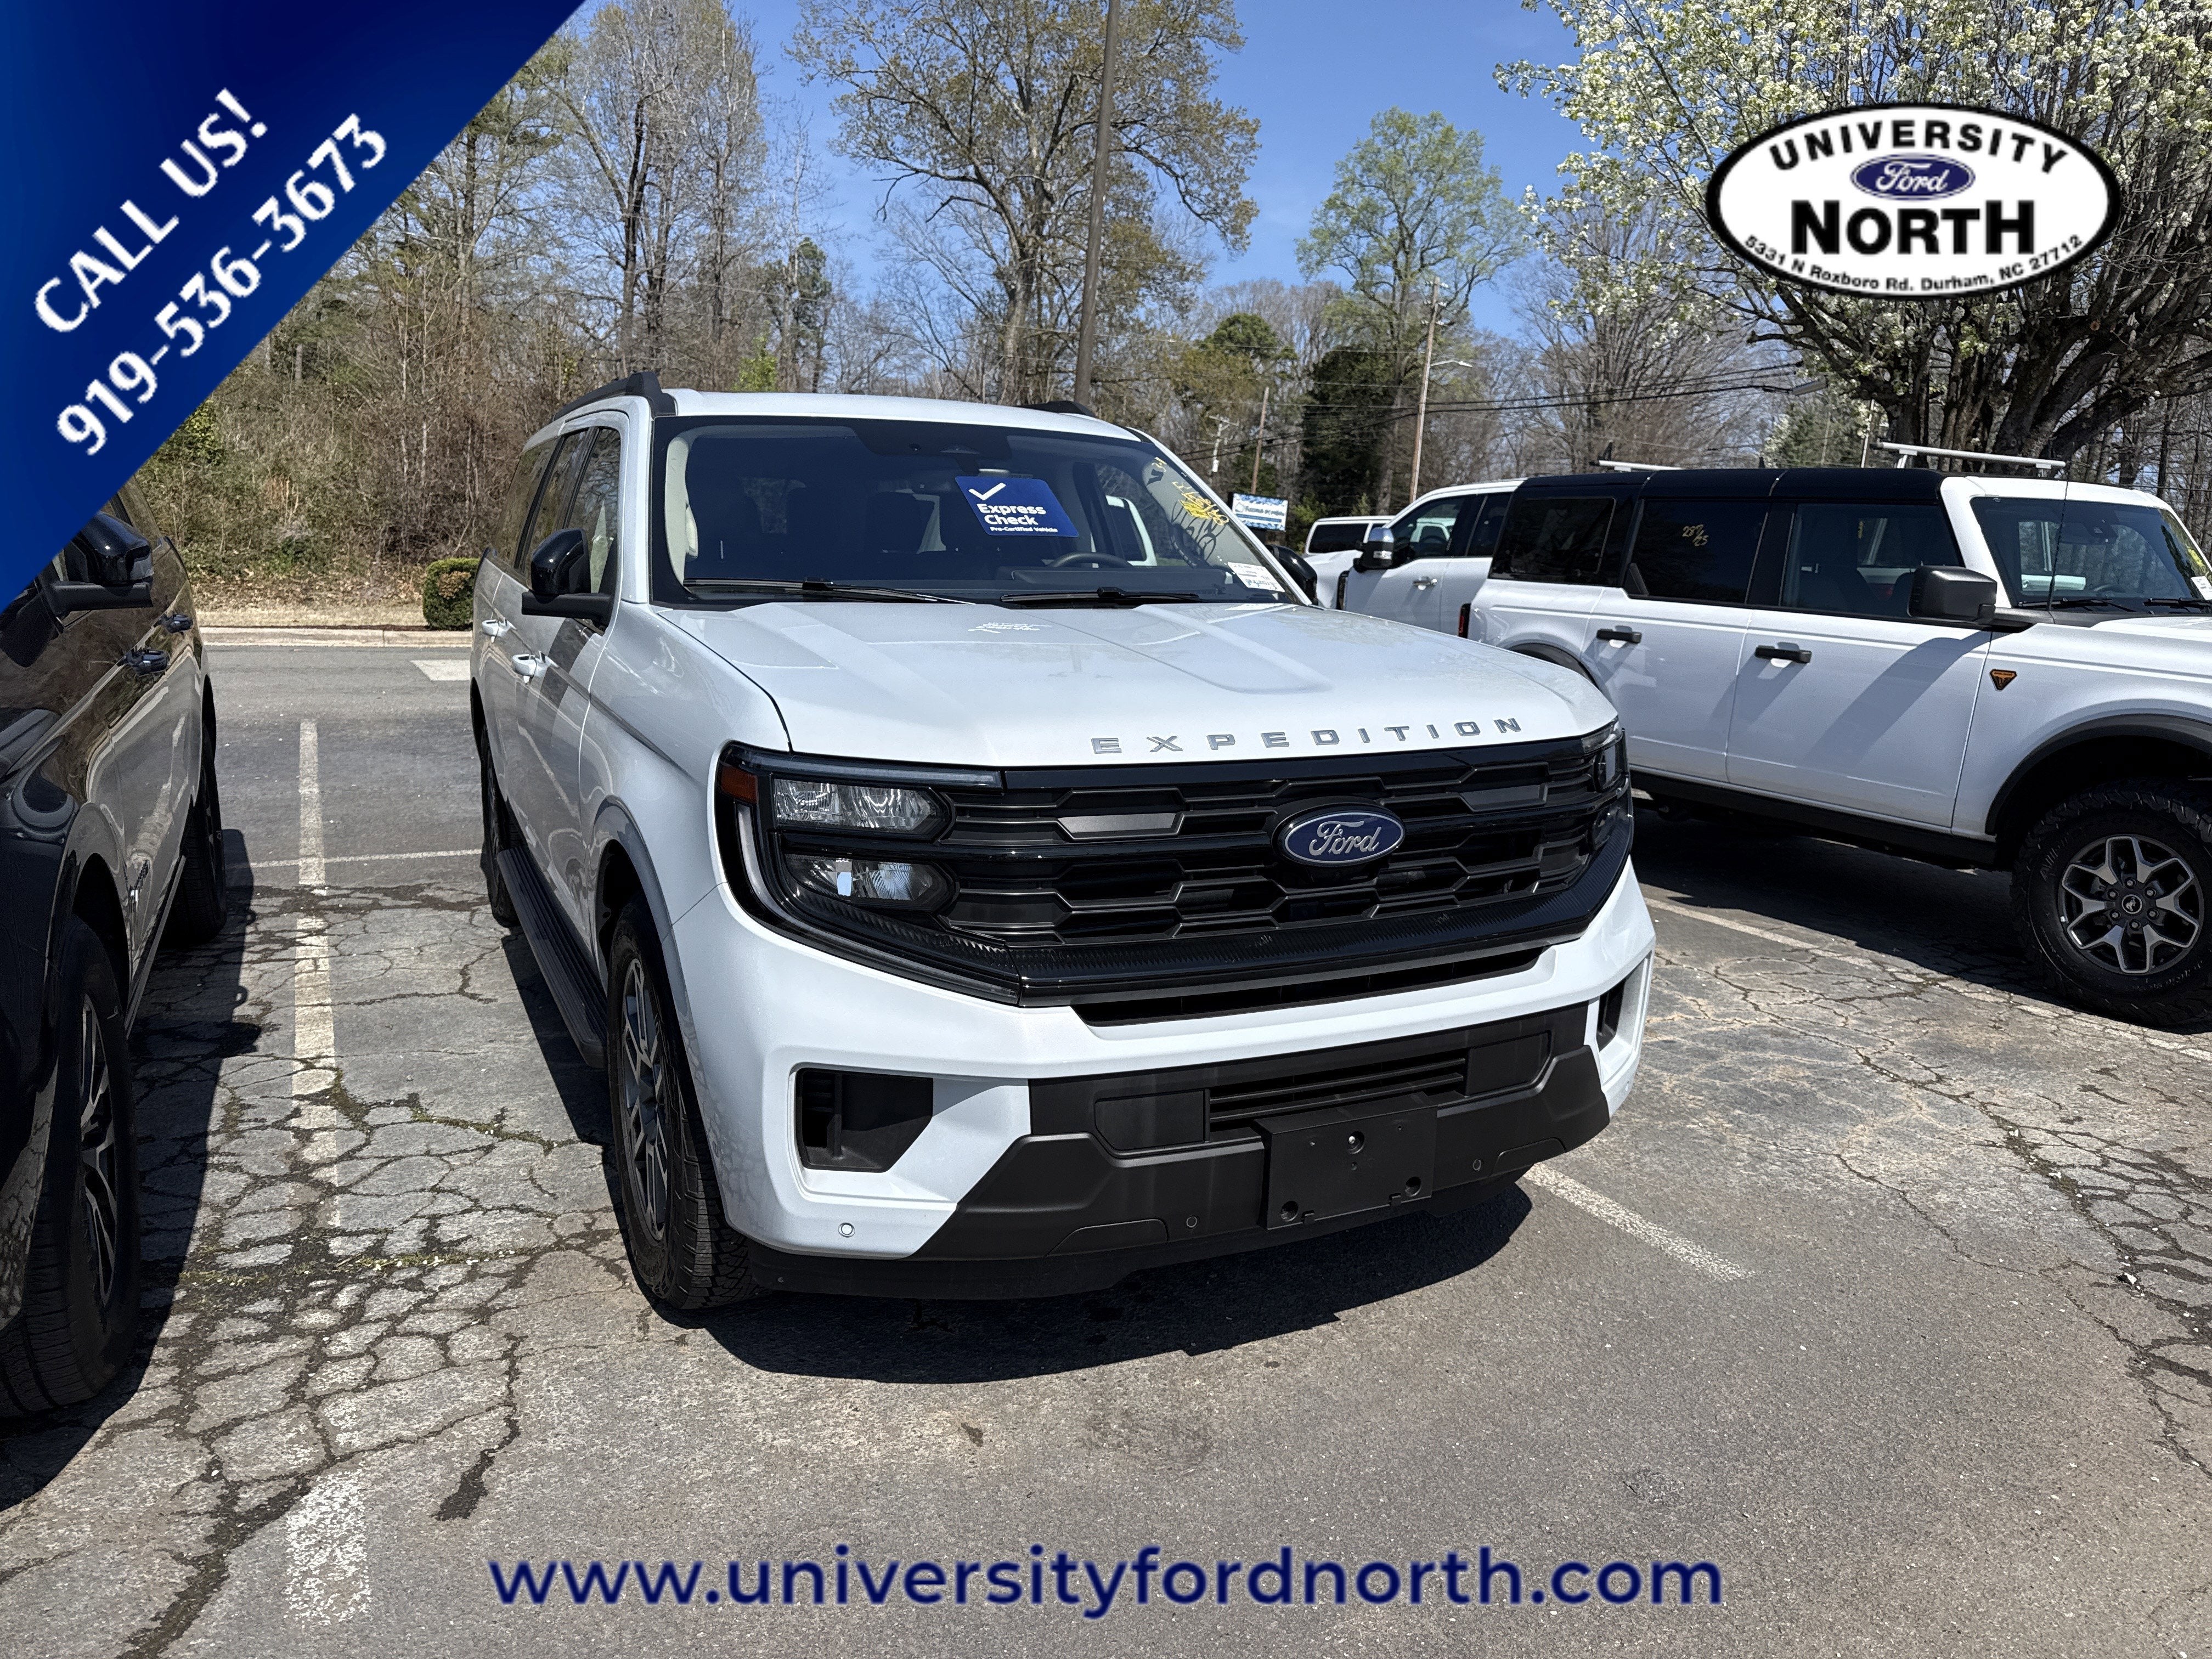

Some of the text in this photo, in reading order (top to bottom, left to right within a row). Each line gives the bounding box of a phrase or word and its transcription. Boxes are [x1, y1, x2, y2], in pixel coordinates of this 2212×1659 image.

[977, 503, 1046, 515] Express
[984, 514, 1039, 526] Check
[1091, 717, 1522, 754] EXPEDITION
[1308, 819, 1380, 857] Ford
